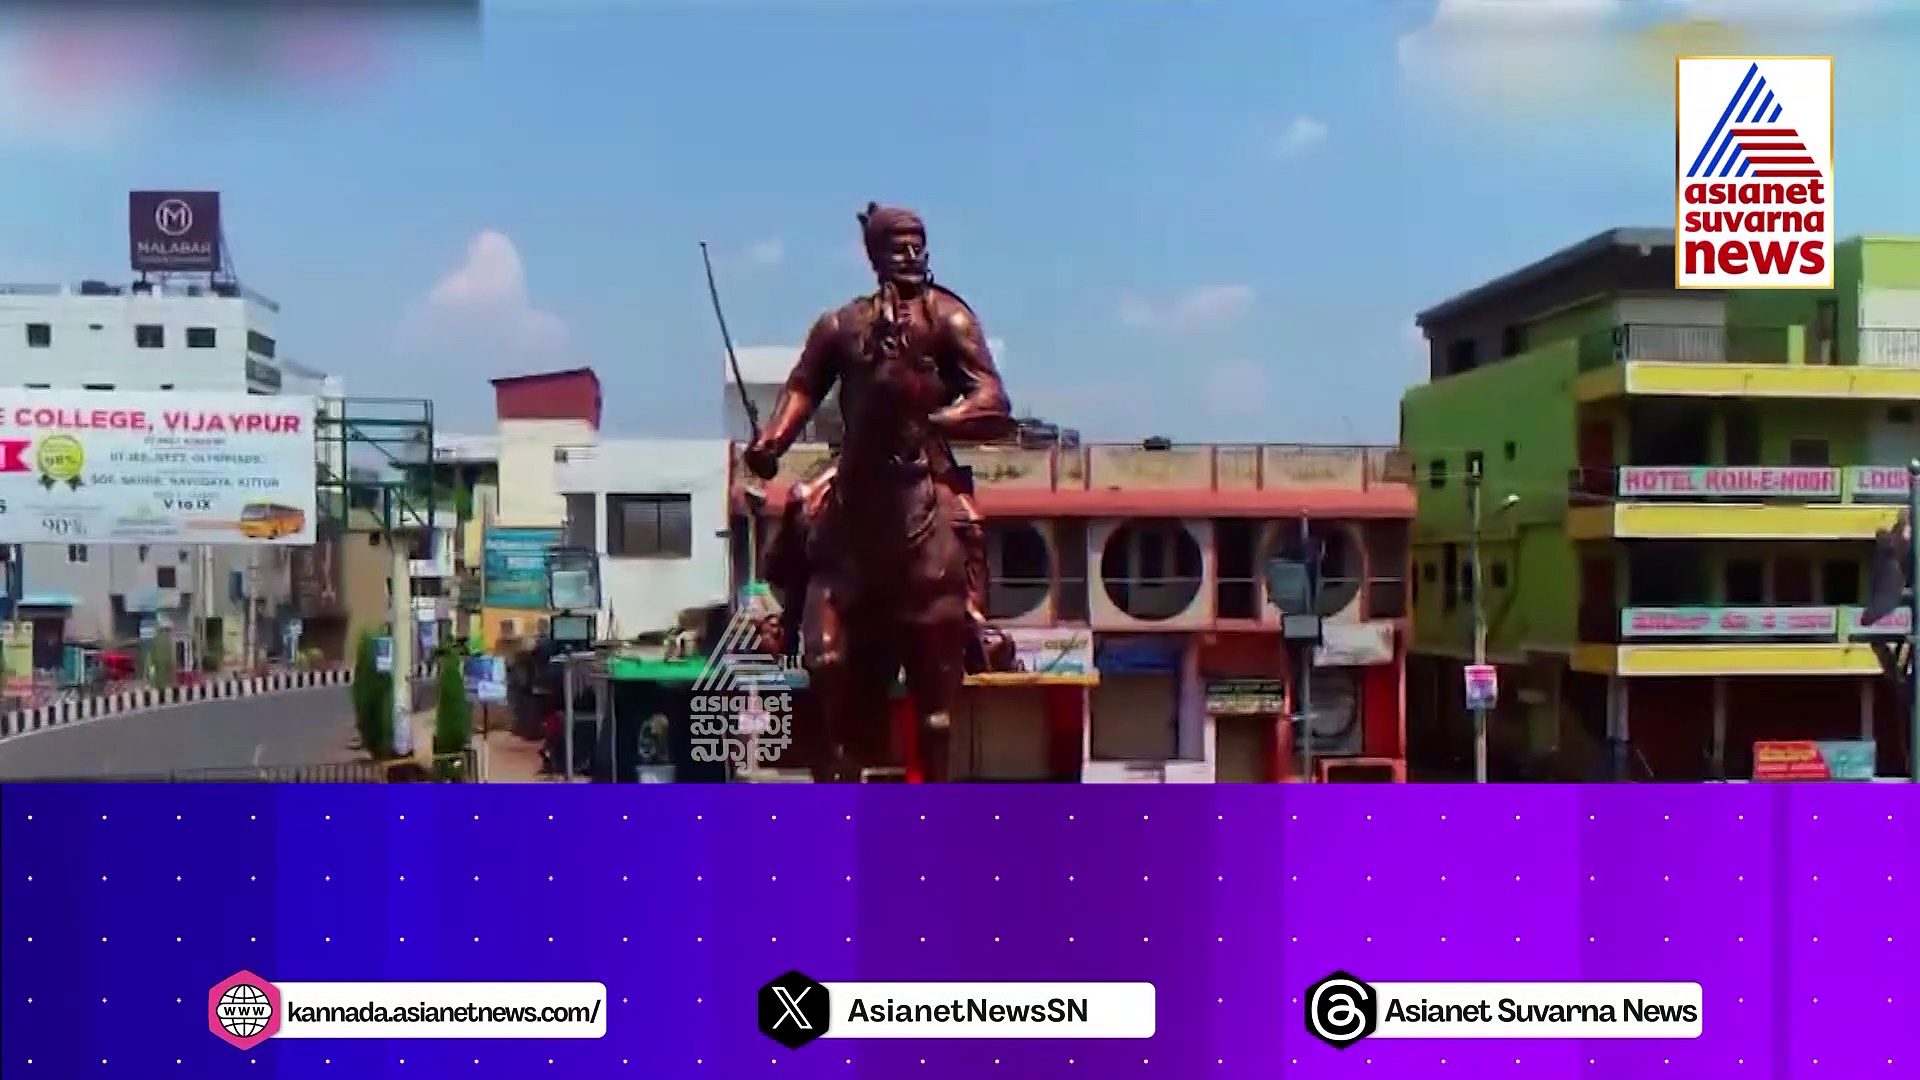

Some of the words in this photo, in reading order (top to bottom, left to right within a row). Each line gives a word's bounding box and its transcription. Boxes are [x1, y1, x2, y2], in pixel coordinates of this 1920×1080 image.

[15, 407, 154, 432] COLLEGE,
[163, 411, 302, 434] VIJAYPUR
[1625, 471, 1698, 491] HOTEL
[162, 499, 174, 510] V
[178, 499, 193, 510] to
[196, 500, 212, 511] IX
